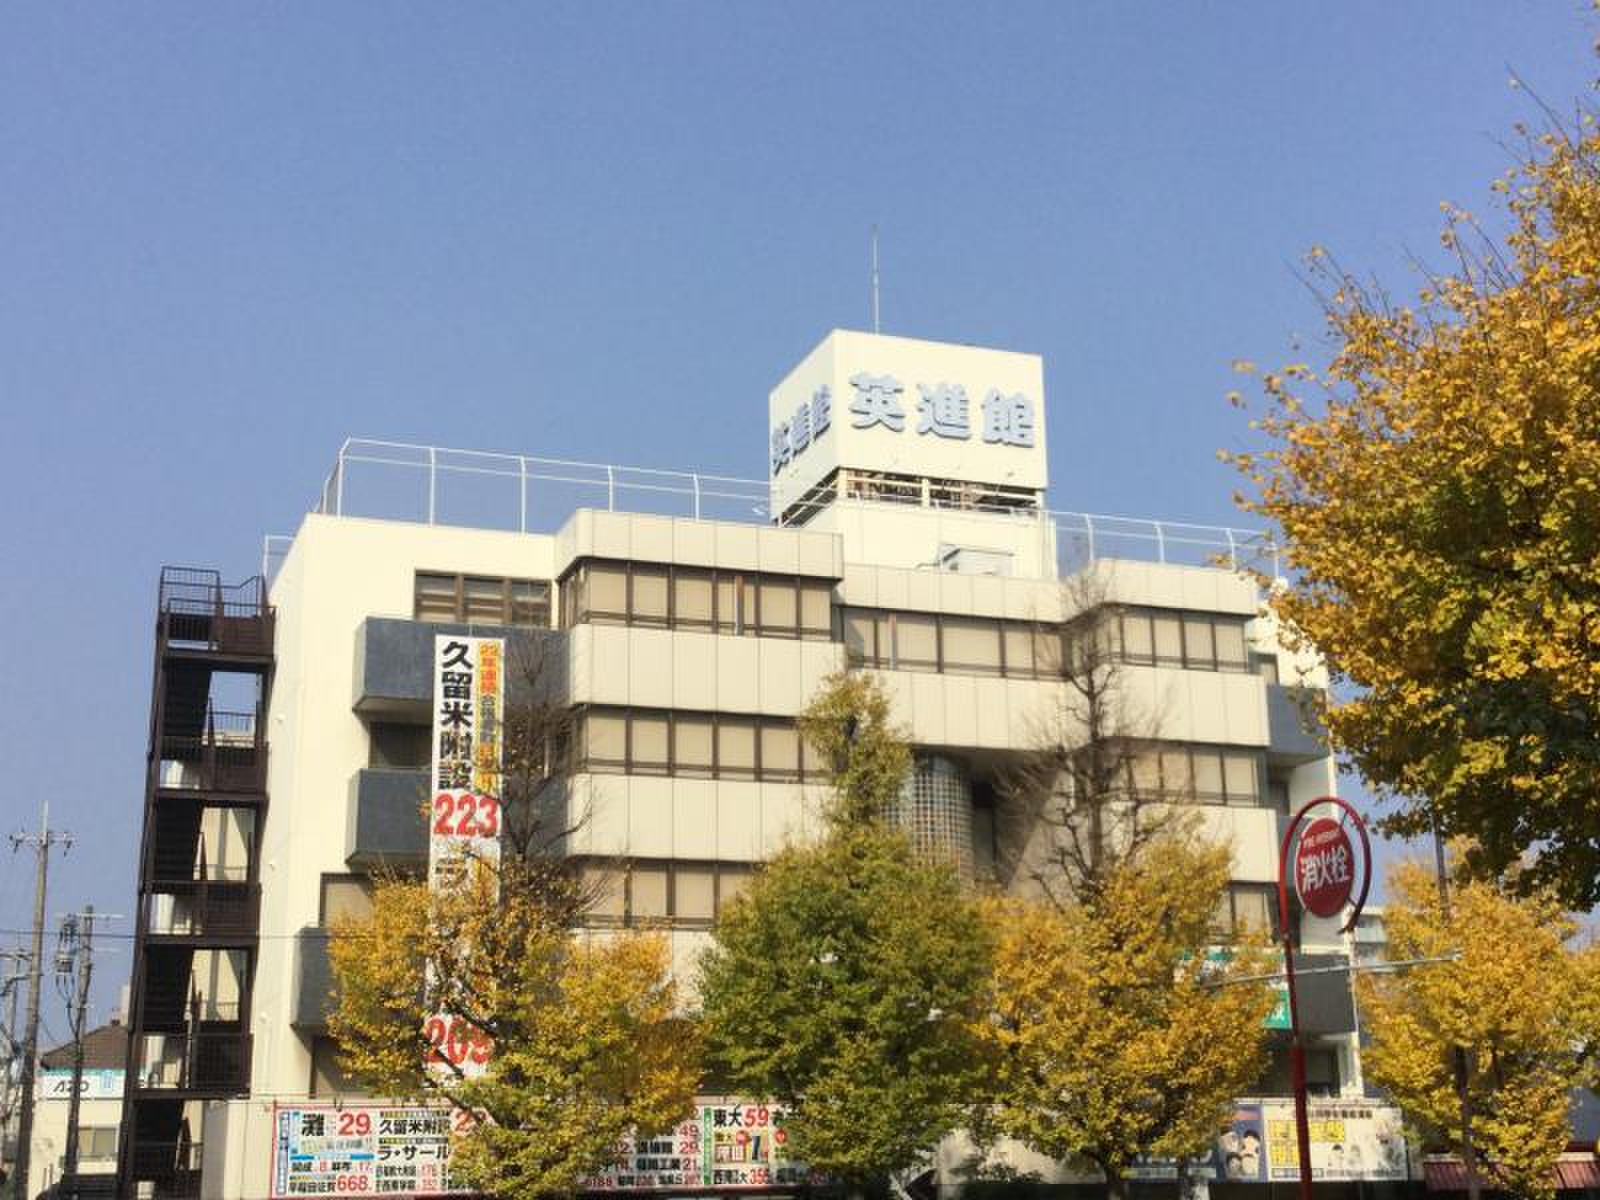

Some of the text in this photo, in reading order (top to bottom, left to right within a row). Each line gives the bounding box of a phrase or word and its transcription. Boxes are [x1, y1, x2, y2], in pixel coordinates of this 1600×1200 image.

[773, 383, 832, 475] 英進館
[850, 372, 1035, 448] 英進館
[433, 793, 498, 838] 223
[1301, 845, 1350, 893] 消火栓
[338, 1112, 371, 1136] 29
[714, 1107, 742, 1127] 東大
[744, 1107, 769, 1128] 59
[337, 1175, 369, 1192] 668
